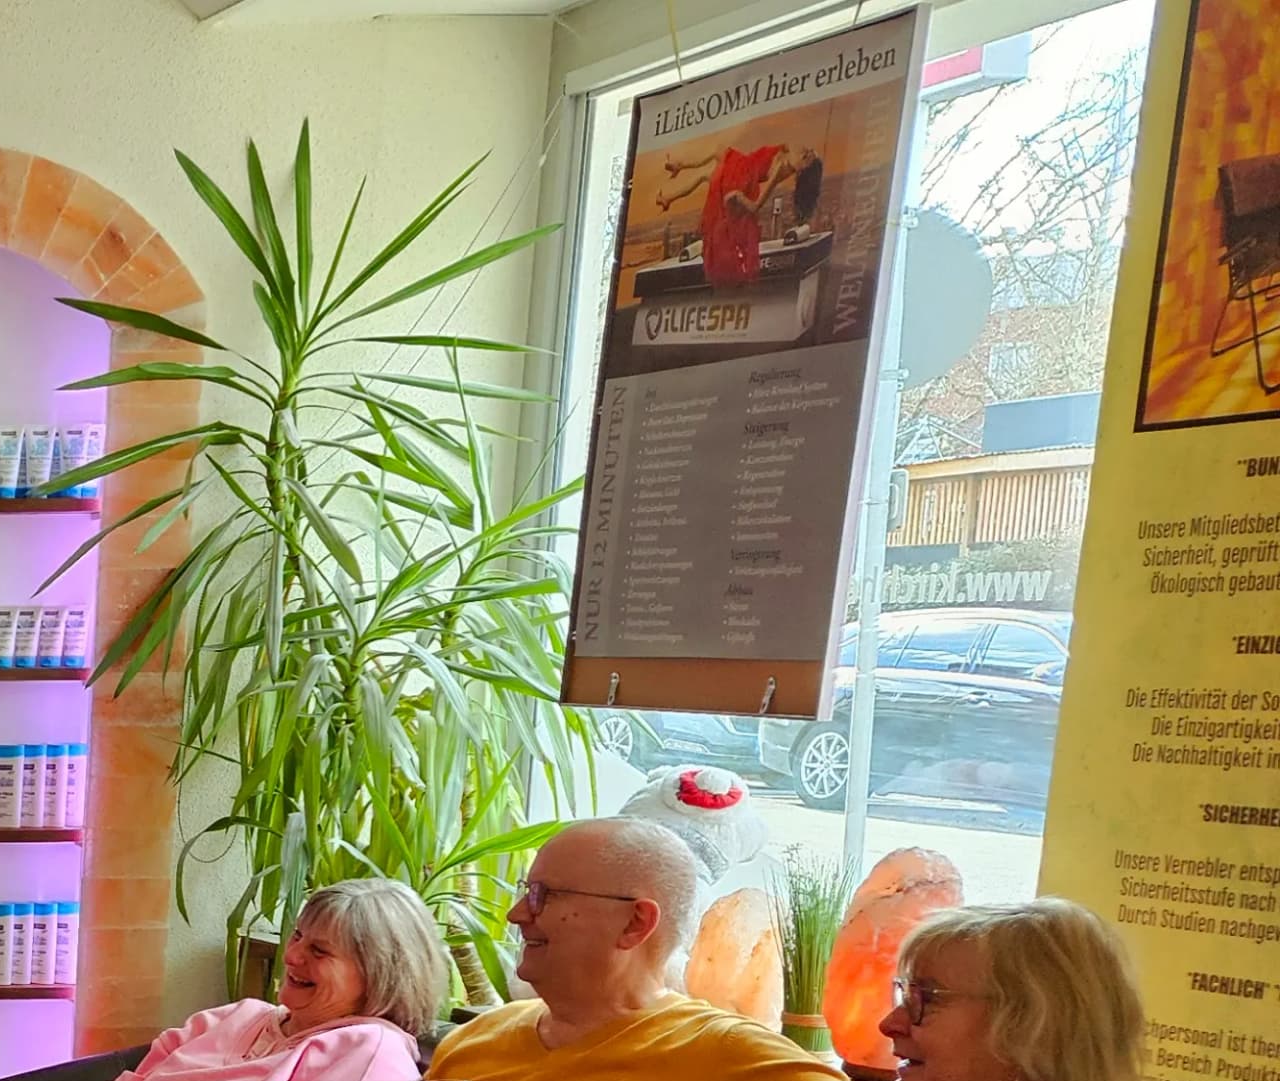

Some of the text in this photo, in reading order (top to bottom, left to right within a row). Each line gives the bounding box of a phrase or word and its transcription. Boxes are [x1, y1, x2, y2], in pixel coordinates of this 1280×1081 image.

[654, 48, 897, 137] iLifeSOMM hier erleben
[584, 384, 627, 642] NUR 12 MINUTEN
[1138, 520, 1186, 540] Unsere
[1143, 540, 1280, 568] Sicherheit, geprüft
[1151, 571, 1225, 598] Ökologisch
[1126, 687, 1147, 708] Die
[1150, 688, 1228, 710] Effektivität
[1231, 690, 1258, 711] der
[1151, 715, 1173, 736] Die
[1132, 742, 1154, 763] Die
[1156, 744, 1264, 772] Nachhaltigkeit
[1114, 850, 1161, 873] Unsere
[1164, 855, 1237, 880] Vernebler
[1120, 876, 1277, 913] Sicherheitsstufe nach
[1118, 904, 1158, 927] Durch
[1160, 909, 1217, 934] Studien
[1227, 1030, 1248, 1054] ist
[1156, 1047, 1213, 1075] Bereich
